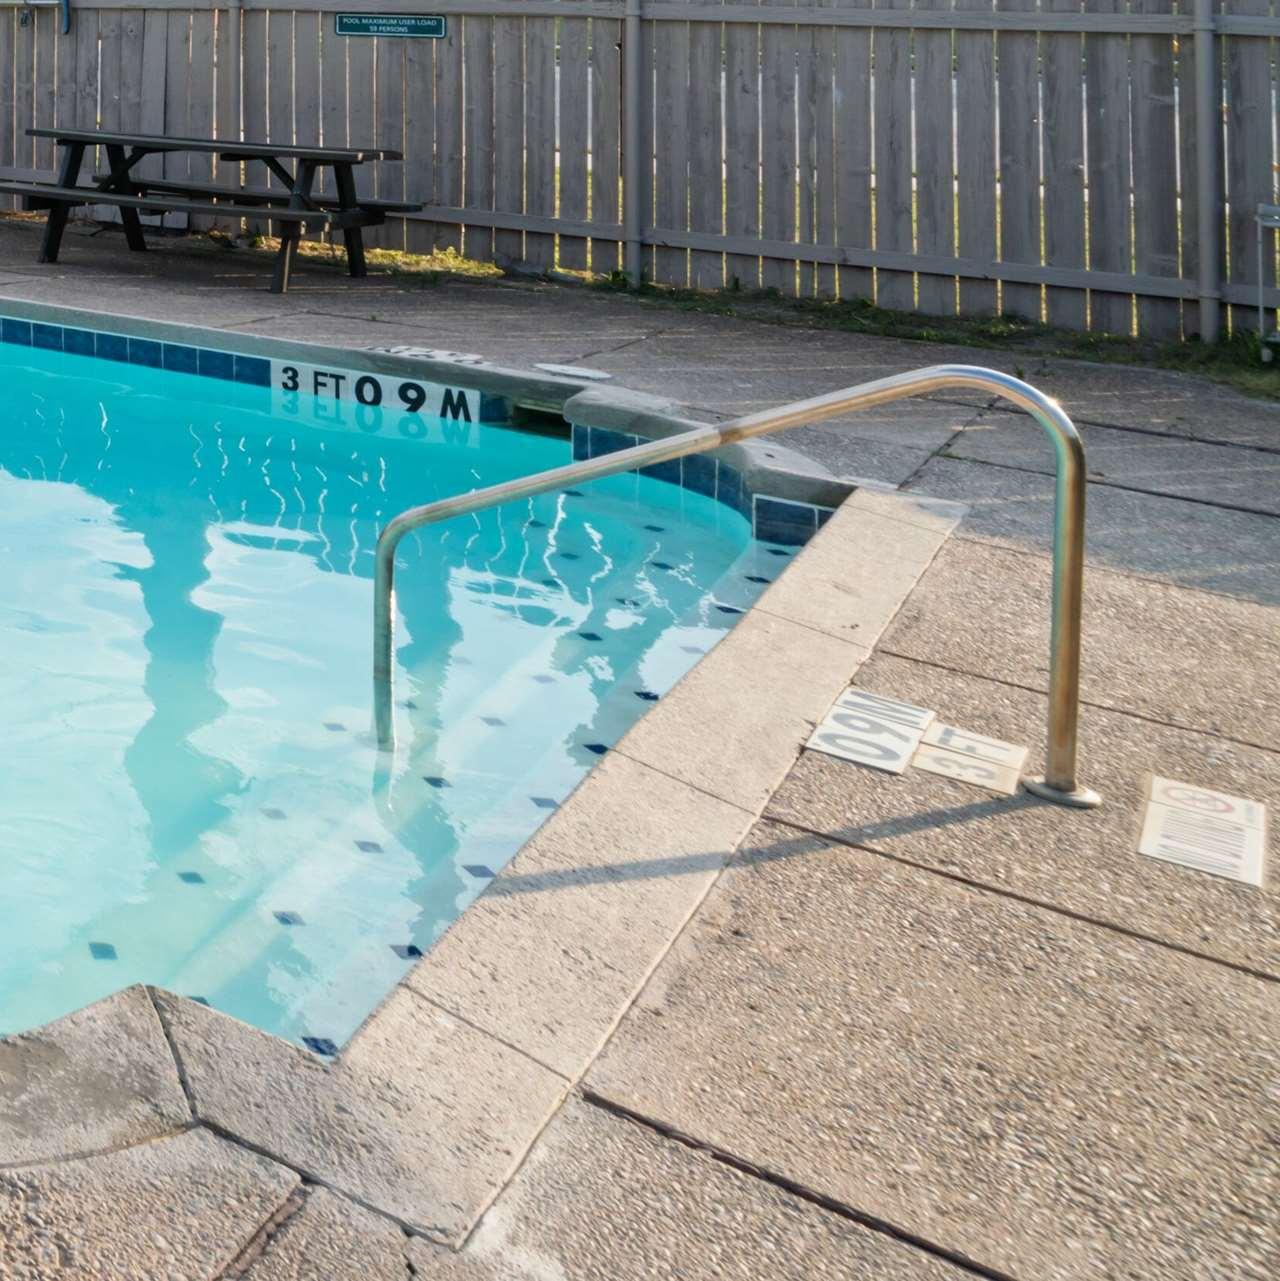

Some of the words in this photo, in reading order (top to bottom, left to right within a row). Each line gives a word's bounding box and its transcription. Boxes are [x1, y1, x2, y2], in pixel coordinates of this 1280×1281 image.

[399, 18, 416, 26] USER
[282, 366, 299, 392] 3
[313, 371, 346, 400] FT
